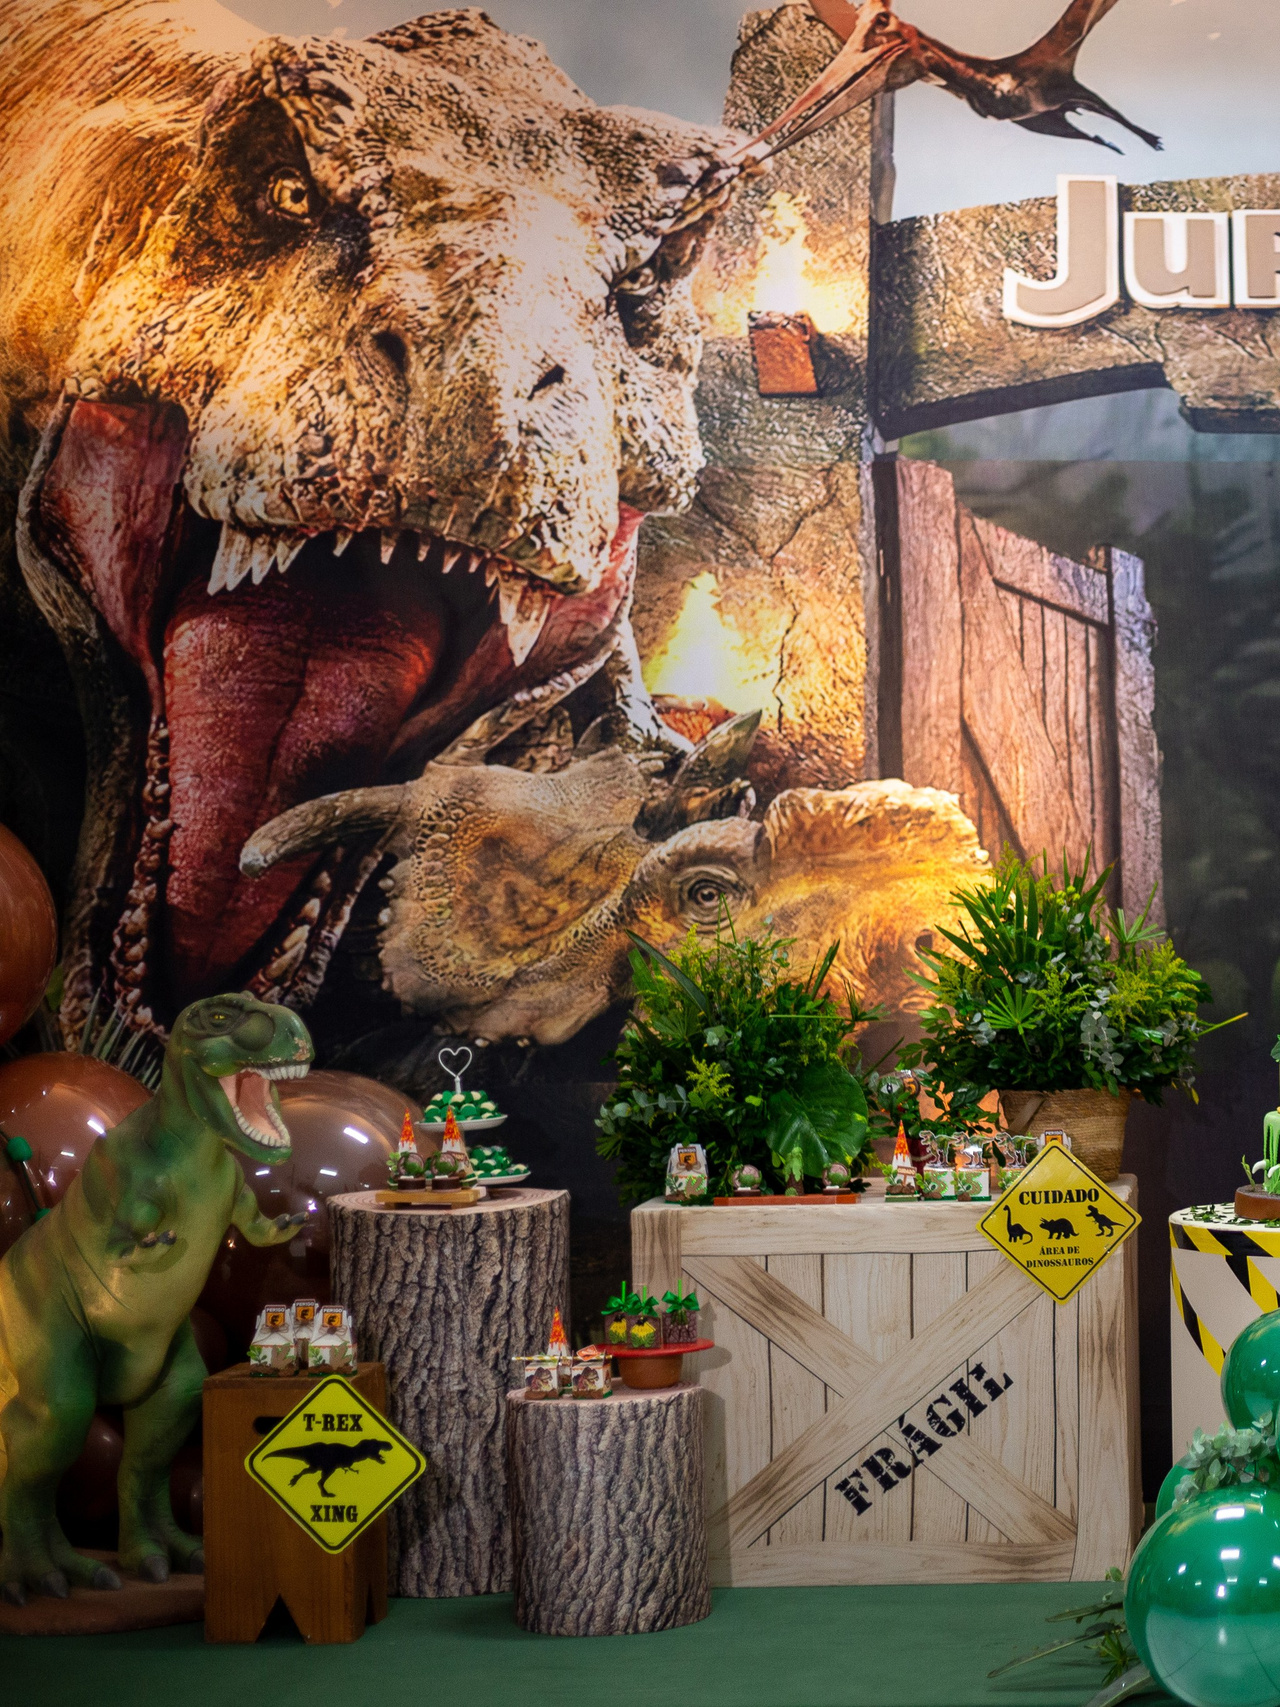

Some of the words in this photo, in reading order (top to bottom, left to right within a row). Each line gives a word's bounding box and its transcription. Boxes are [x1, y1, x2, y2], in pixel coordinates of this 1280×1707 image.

[1018, 1188, 1100, 1206] CUIDADO
[1039, 1246, 1065, 1256] ÁREA
[1067, 1246, 1080, 1255] DE
[1026, 1257, 1095, 1268] DINOSSAUROS
[303, 1413, 363, 1432] T-REX
[834, 1361, 1014, 1516] FRÁGIL
[310, 1505, 359, 1523] XING
